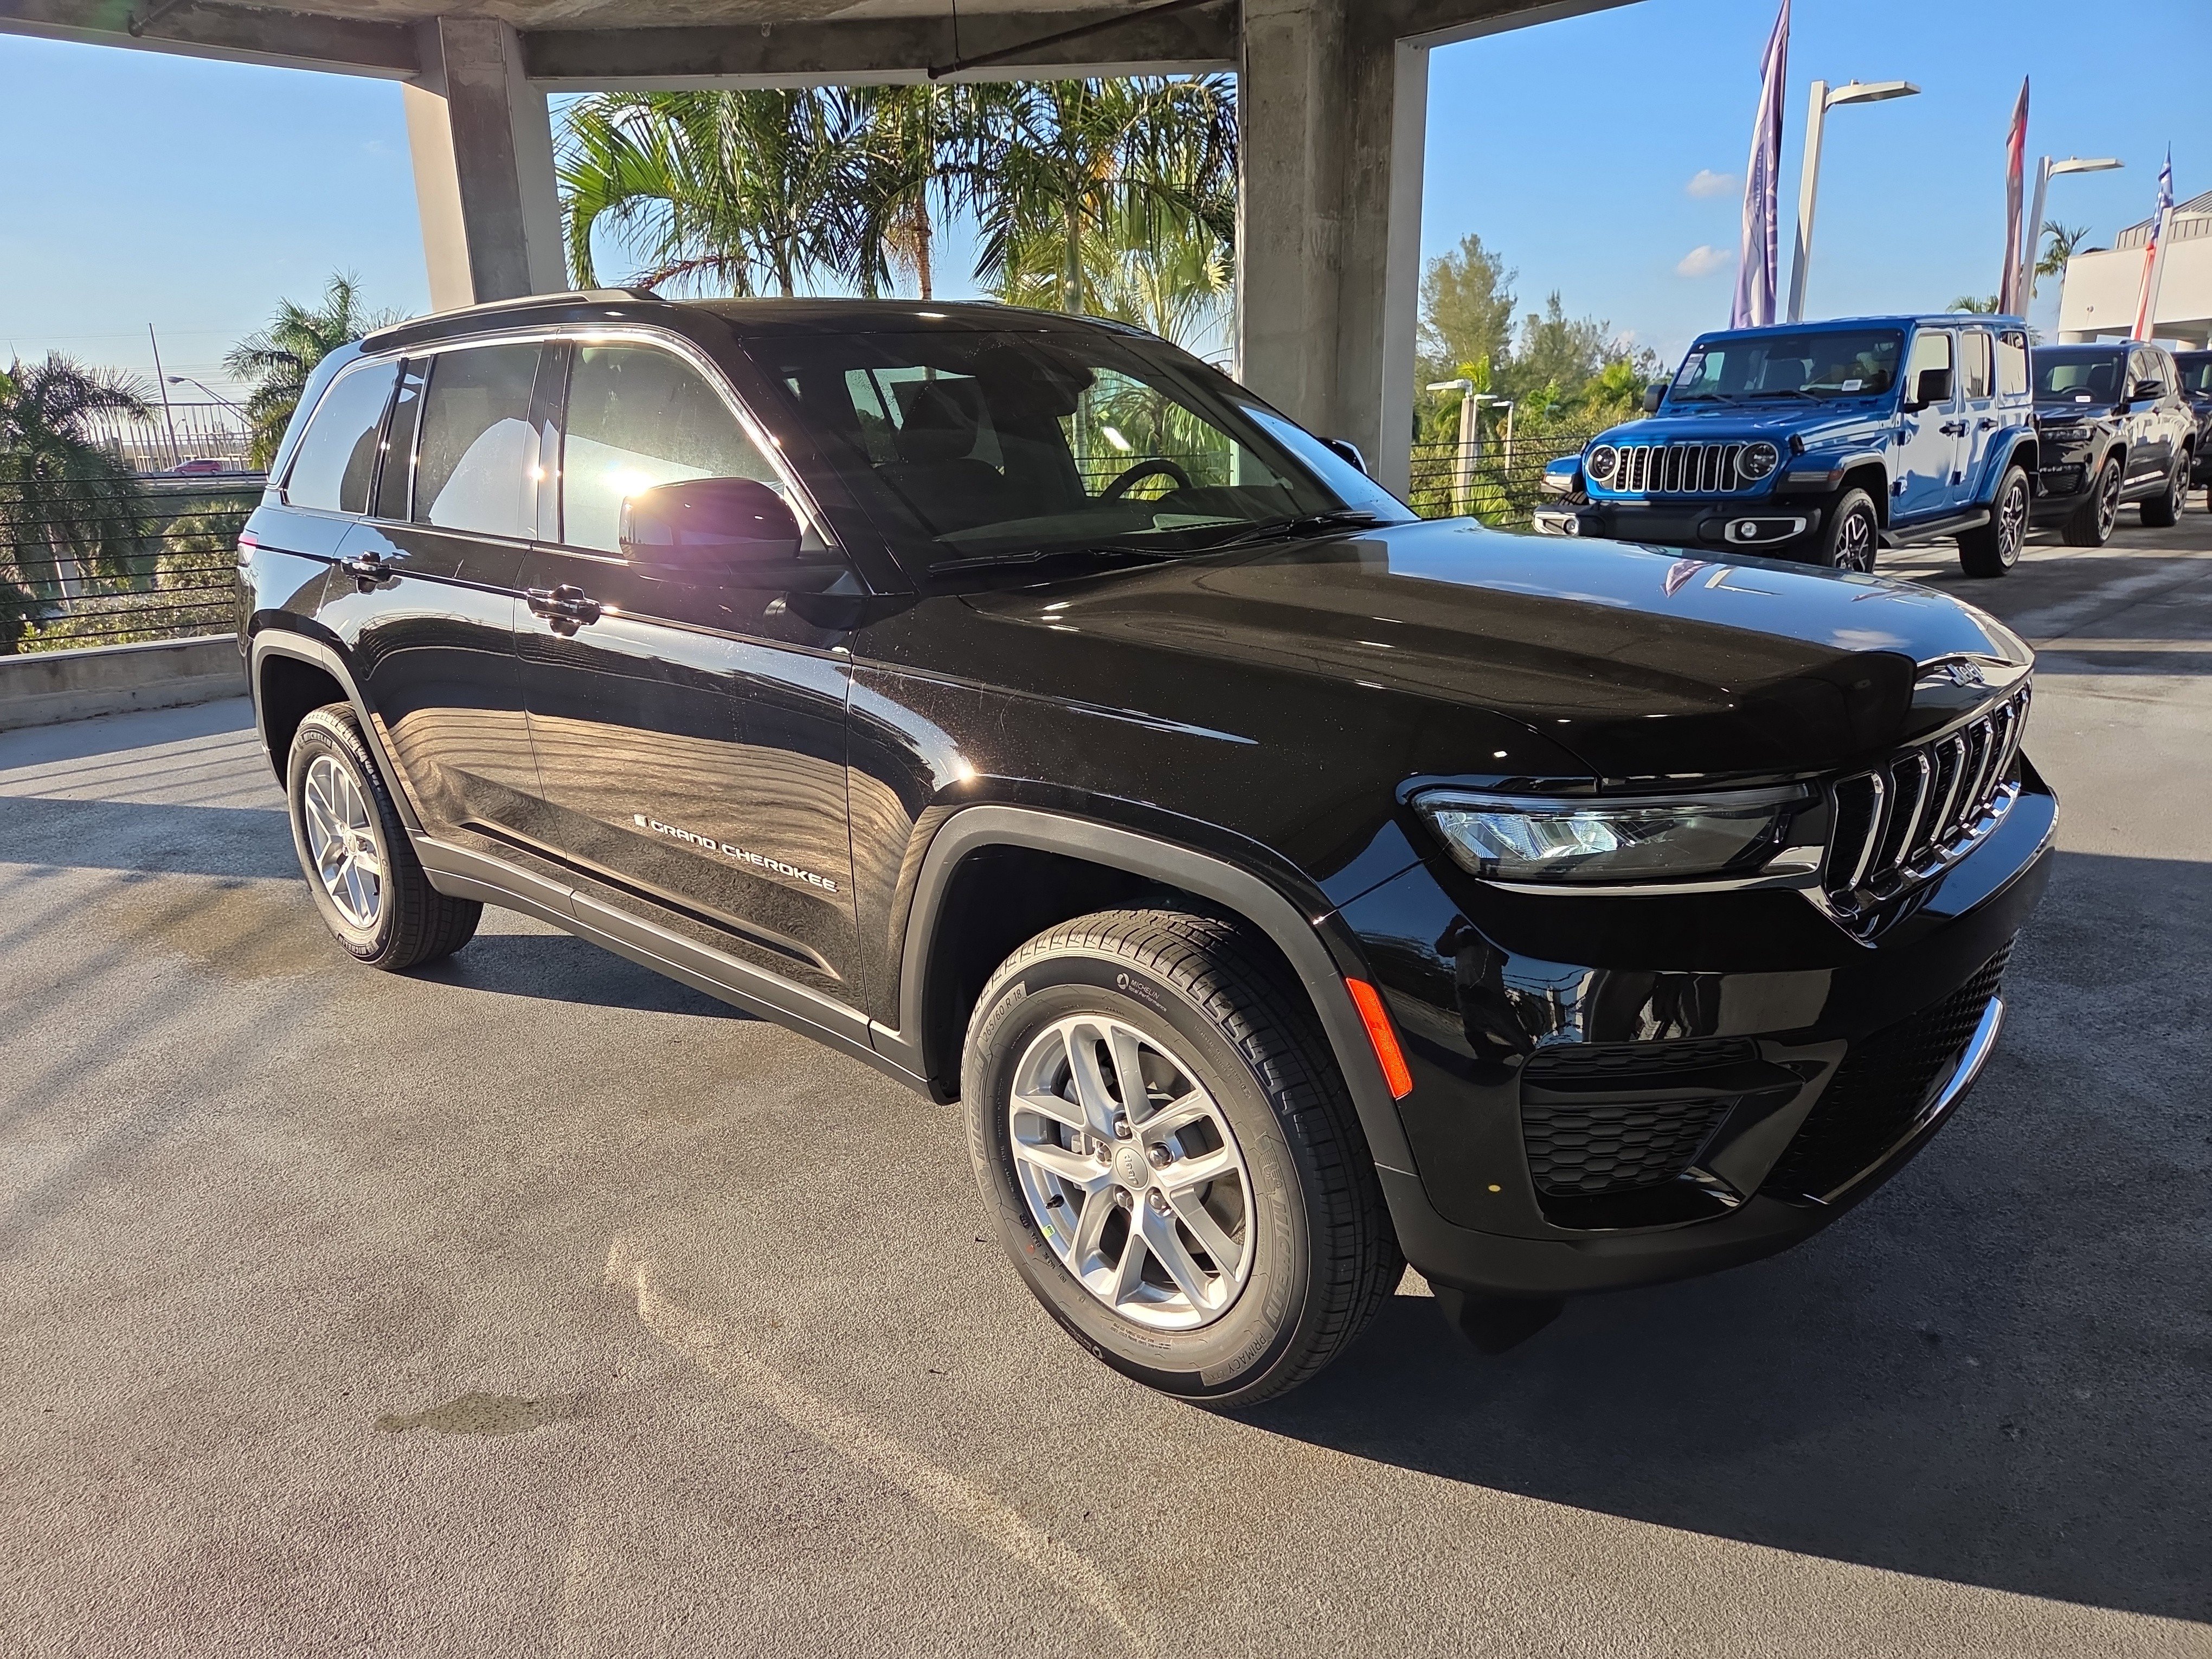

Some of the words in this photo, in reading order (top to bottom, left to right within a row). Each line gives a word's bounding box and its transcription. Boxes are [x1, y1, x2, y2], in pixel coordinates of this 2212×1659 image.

[1946, 661, 1985, 686] Jeep
[304, 731, 332, 748] MICHELIN
[651, 819, 718, 850] GRAND
[722, 844, 839, 893] CHEROKEE
[338, 935, 367, 955] MICHELIN
[1128, 985, 1139, 994] Total
[1139, 991, 1167, 1012] Performance
[1130, 979, 1160, 999] MICHELIN
[983, 1005, 1005, 1043] 265/60
[1005, 998, 1012, 1009] R
[1013, 989, 1022, 1001] 18
[970, 1049, 985, 1161] MICHELIN
[1124, 1154, 1139, 1185] Jeep
[1266, 1199, 1290, 1323] MICHELIN
[1228, 1333, 1266, 1374] PRIMACY
